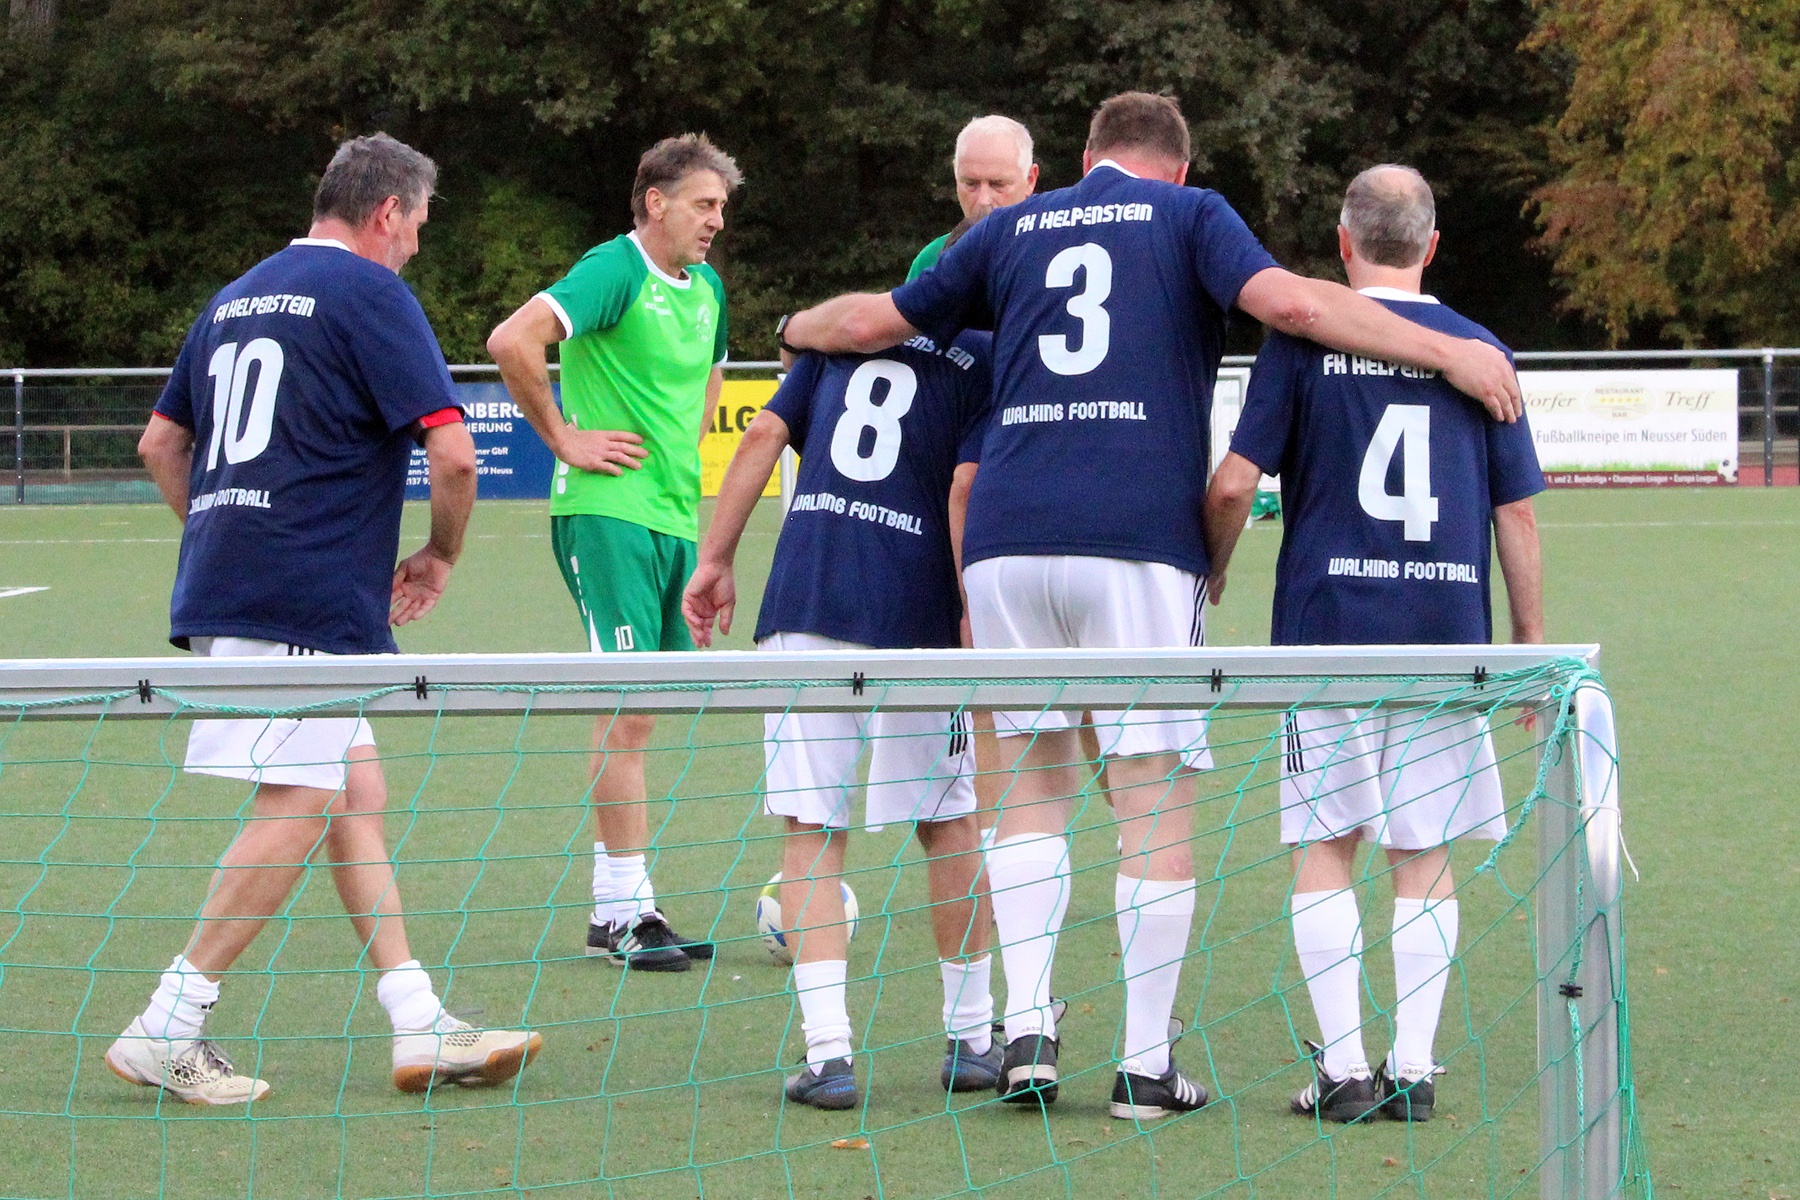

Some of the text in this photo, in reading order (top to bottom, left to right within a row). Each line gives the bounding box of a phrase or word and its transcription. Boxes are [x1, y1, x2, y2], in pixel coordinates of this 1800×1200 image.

[1015, 203, 1153, 236] FK HELPENSTEIN
[226, 294, 316, 318] HELPENSTEIN
[1038, 242, 1113, 376] 3
[1323, 353, 1347, 376] FK
[206, 338, 284, 472] 10
[1002, 401, 1147, 426] WALKING FOOTBALL
[1665, 390, 1715, 411] Treff
[830, 359, 917, 482] 8
[1536, 428, 1727, 445] Fußballkneipe im Neusser Süden
[490, 467, 513, 475] Neuss
[1358, 404, 1439, 542] 4
[849, 500, 922, 535] FOOTBALL
[1328, 557, 1478, 583] WALKING FOOTBALL
[614, 625, 634, 651] 10
